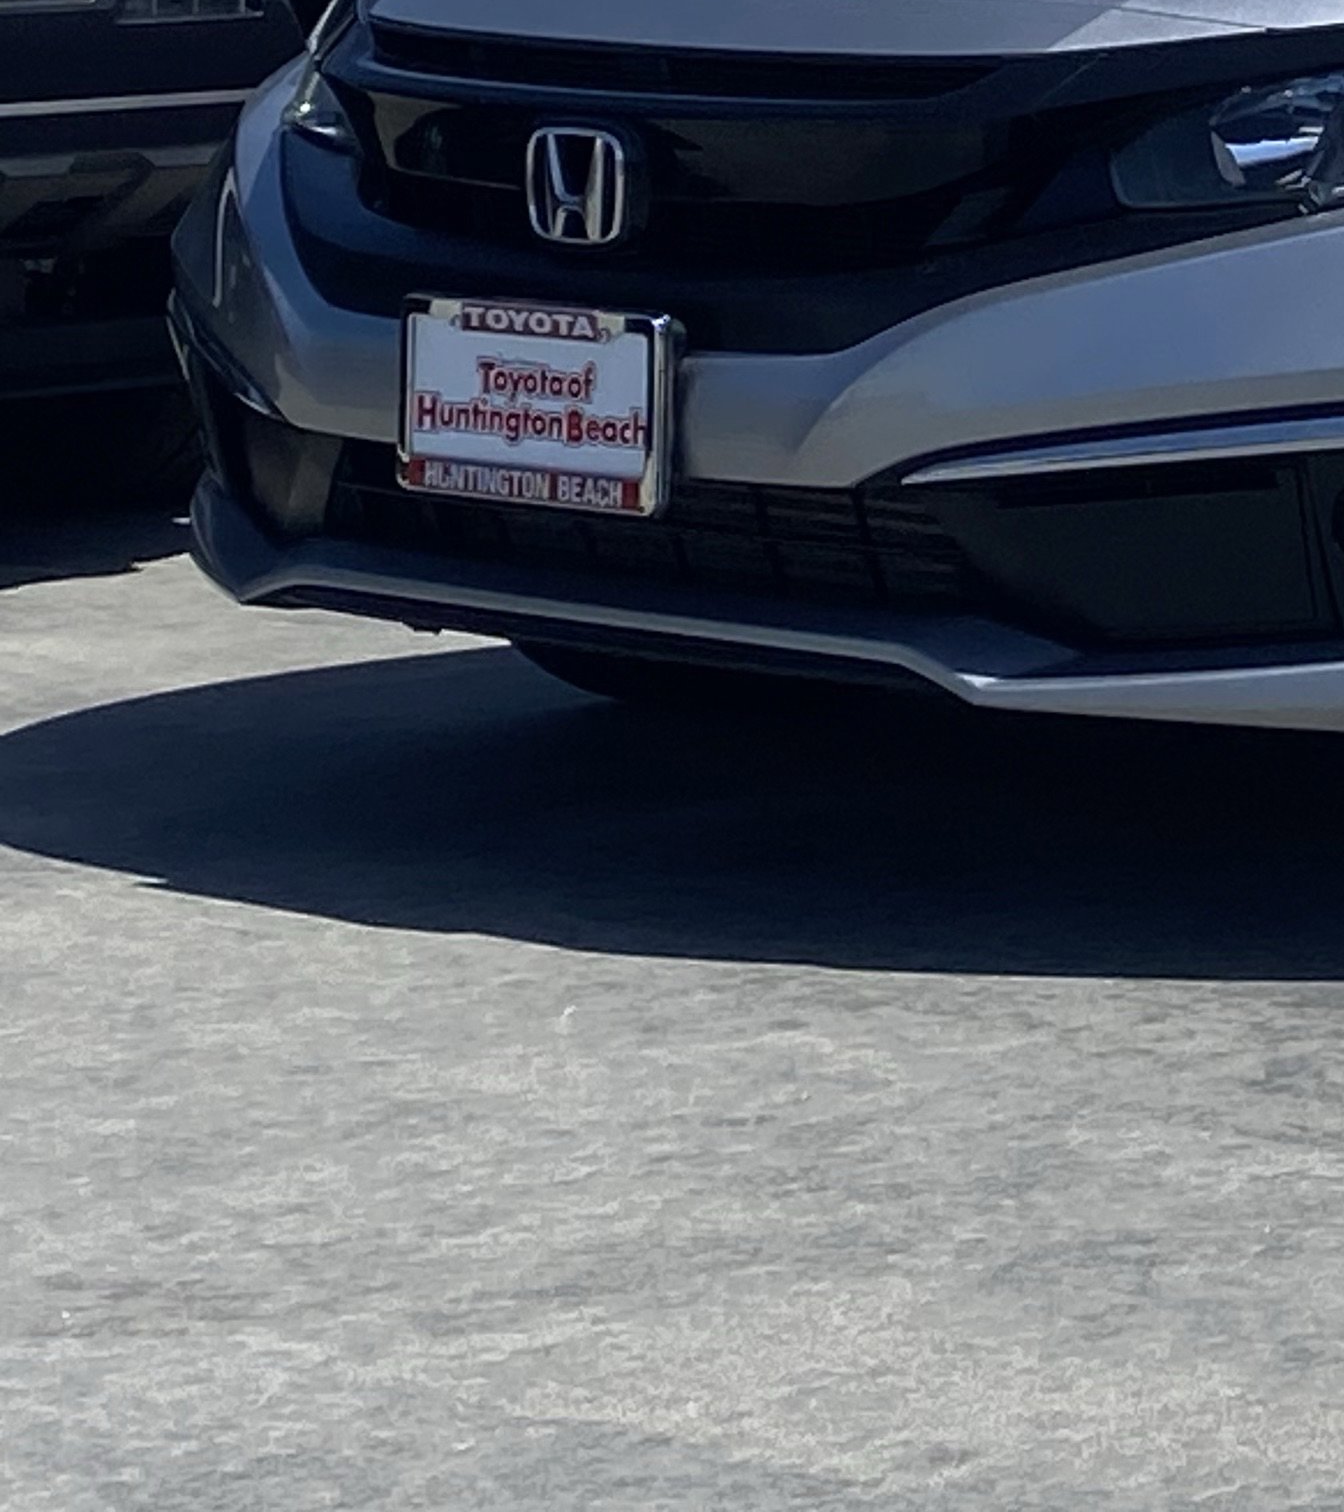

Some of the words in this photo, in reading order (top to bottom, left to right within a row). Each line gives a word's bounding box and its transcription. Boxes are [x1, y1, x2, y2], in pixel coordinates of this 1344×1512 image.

[462, 306, 595, 338] TOYOTA
[477, 360, 563, 402] Toyota
[566, 362, 597, 398] of
[416, 394, 563, 441] Huntington
[565, 408, 646, 445] Beach
[424, 459, 549, 499] HUNTINGTON
[556, 476, 623, 507] BEACH
